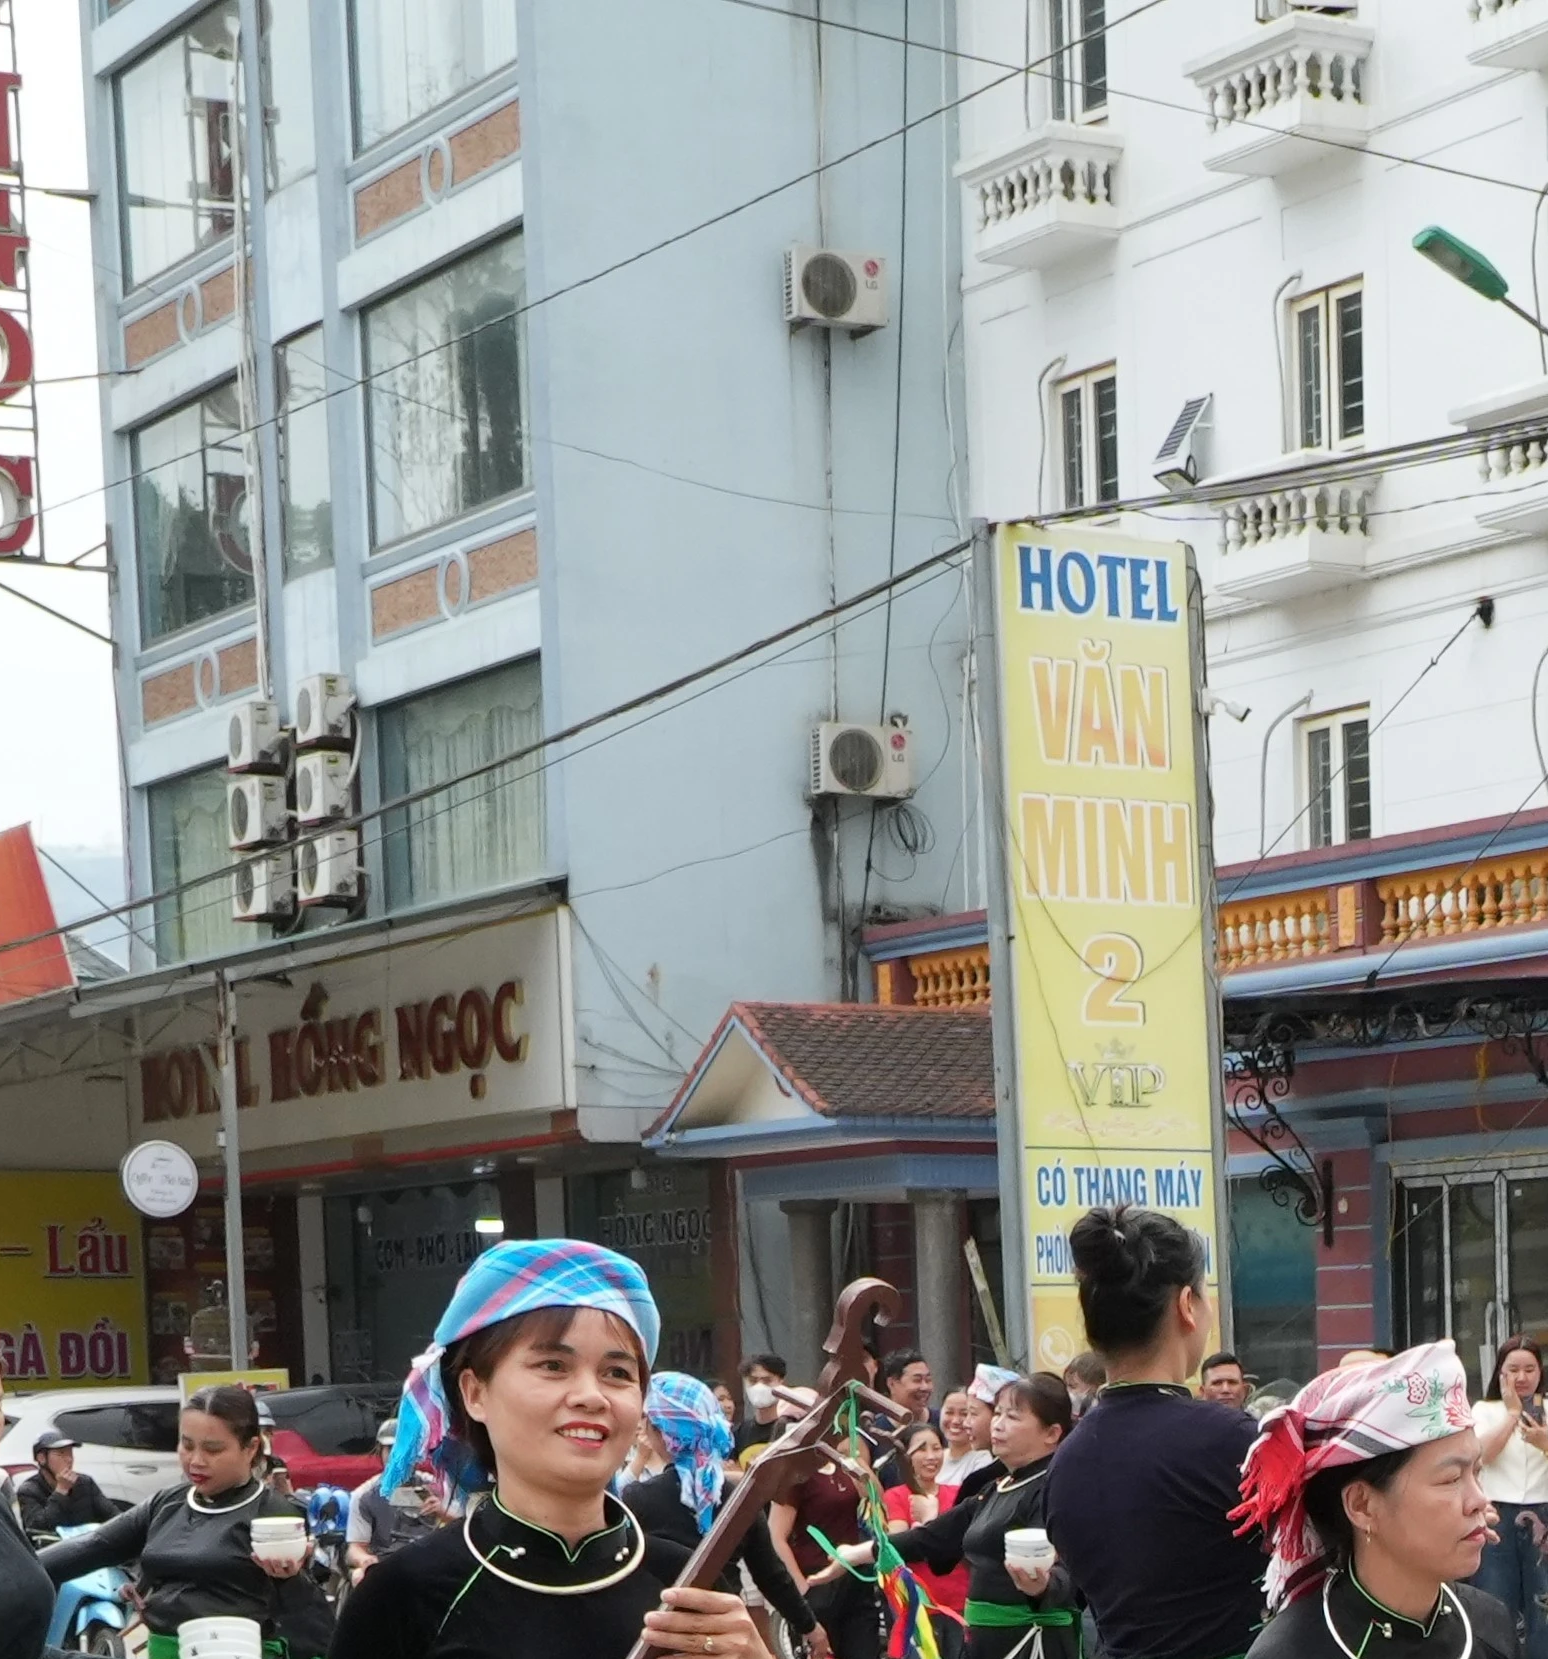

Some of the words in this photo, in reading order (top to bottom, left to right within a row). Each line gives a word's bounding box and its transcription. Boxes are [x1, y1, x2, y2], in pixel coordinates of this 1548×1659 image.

[1018, 545, 1178, 622] HOTEL
[1029, 638, 1170, 772] VĂN
[1018, 793, 1195, 907] MINH
[1082, 933, 1145, 1026] 2
[395, 980, 528, 1100] NGỌC
[1069, 1062, 1165, 1108] VIP
[1037, 1158, 1067, 1206] CÓ
[1074, 1166, 1147, 1206] THANG
[1155, 1160, 1202, 1207] MÁY
[43, 1215, 133, 1280] Lẩu
